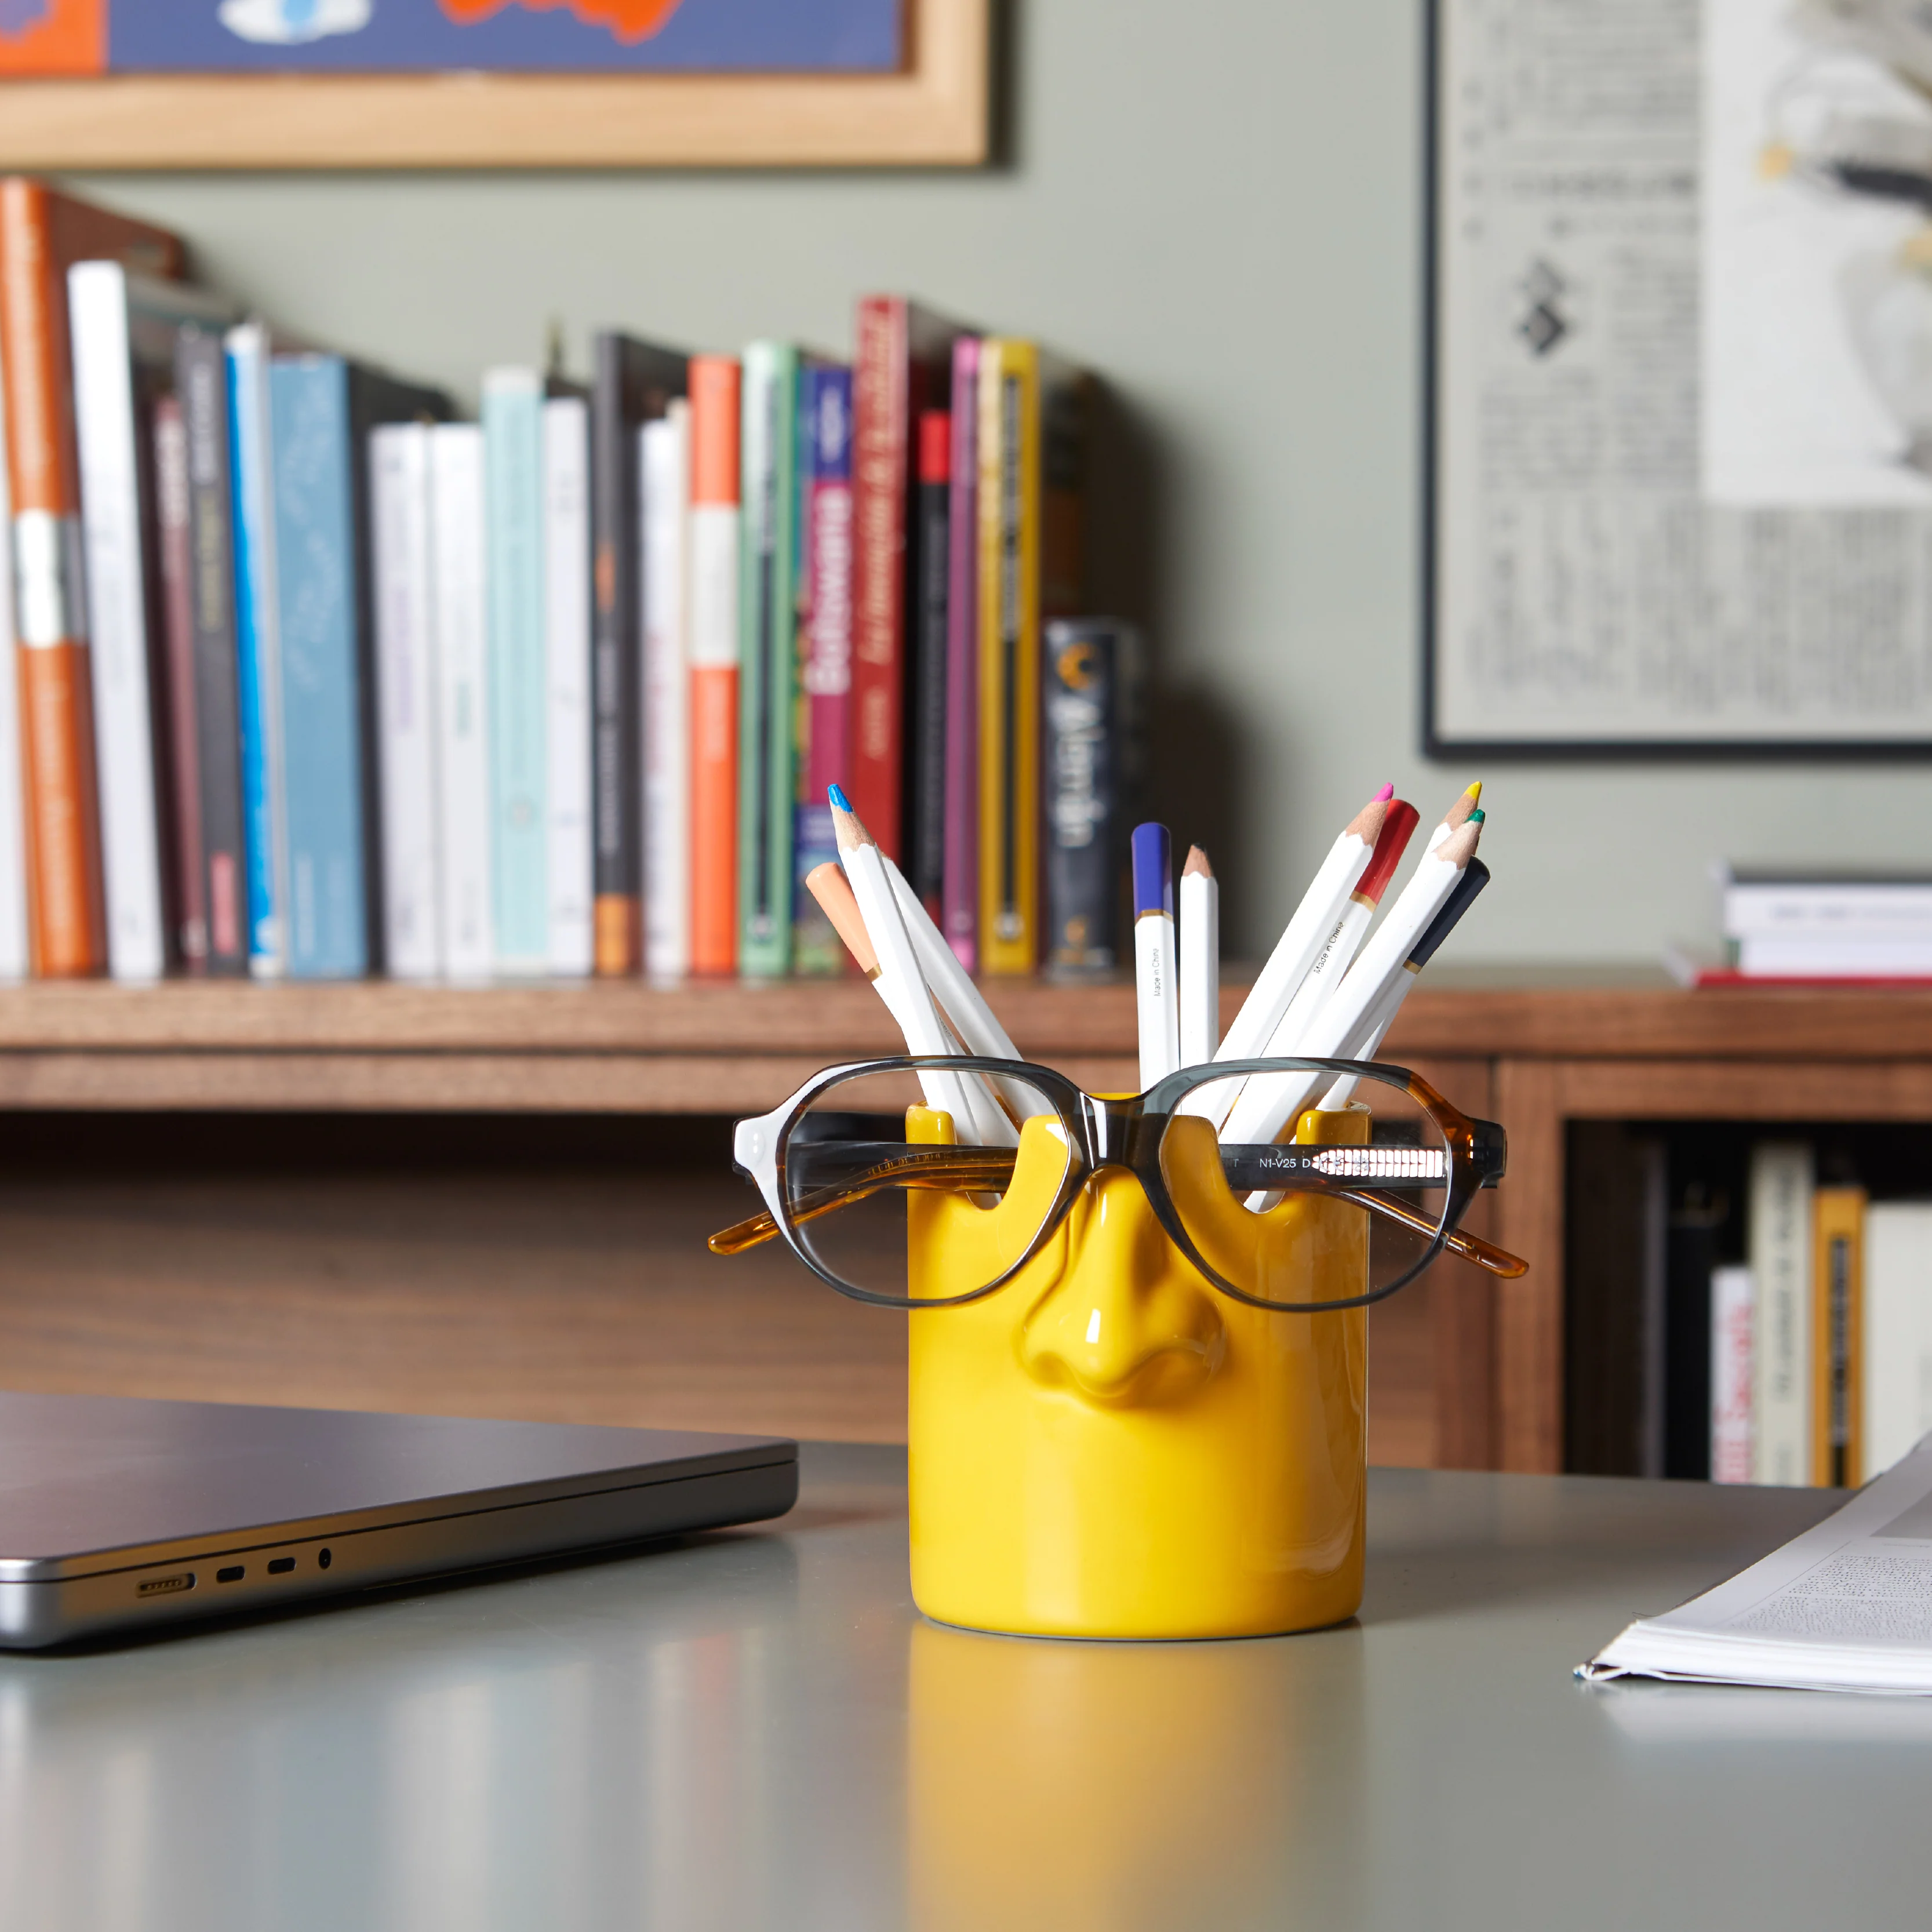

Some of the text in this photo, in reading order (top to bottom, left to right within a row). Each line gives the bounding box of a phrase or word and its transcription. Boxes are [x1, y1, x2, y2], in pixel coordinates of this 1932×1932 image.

[1313, 953, 1329, 974] Made
[1329, 922, 1344, 943] China
[1259, 1158, 1297, 1169] N1-V25
